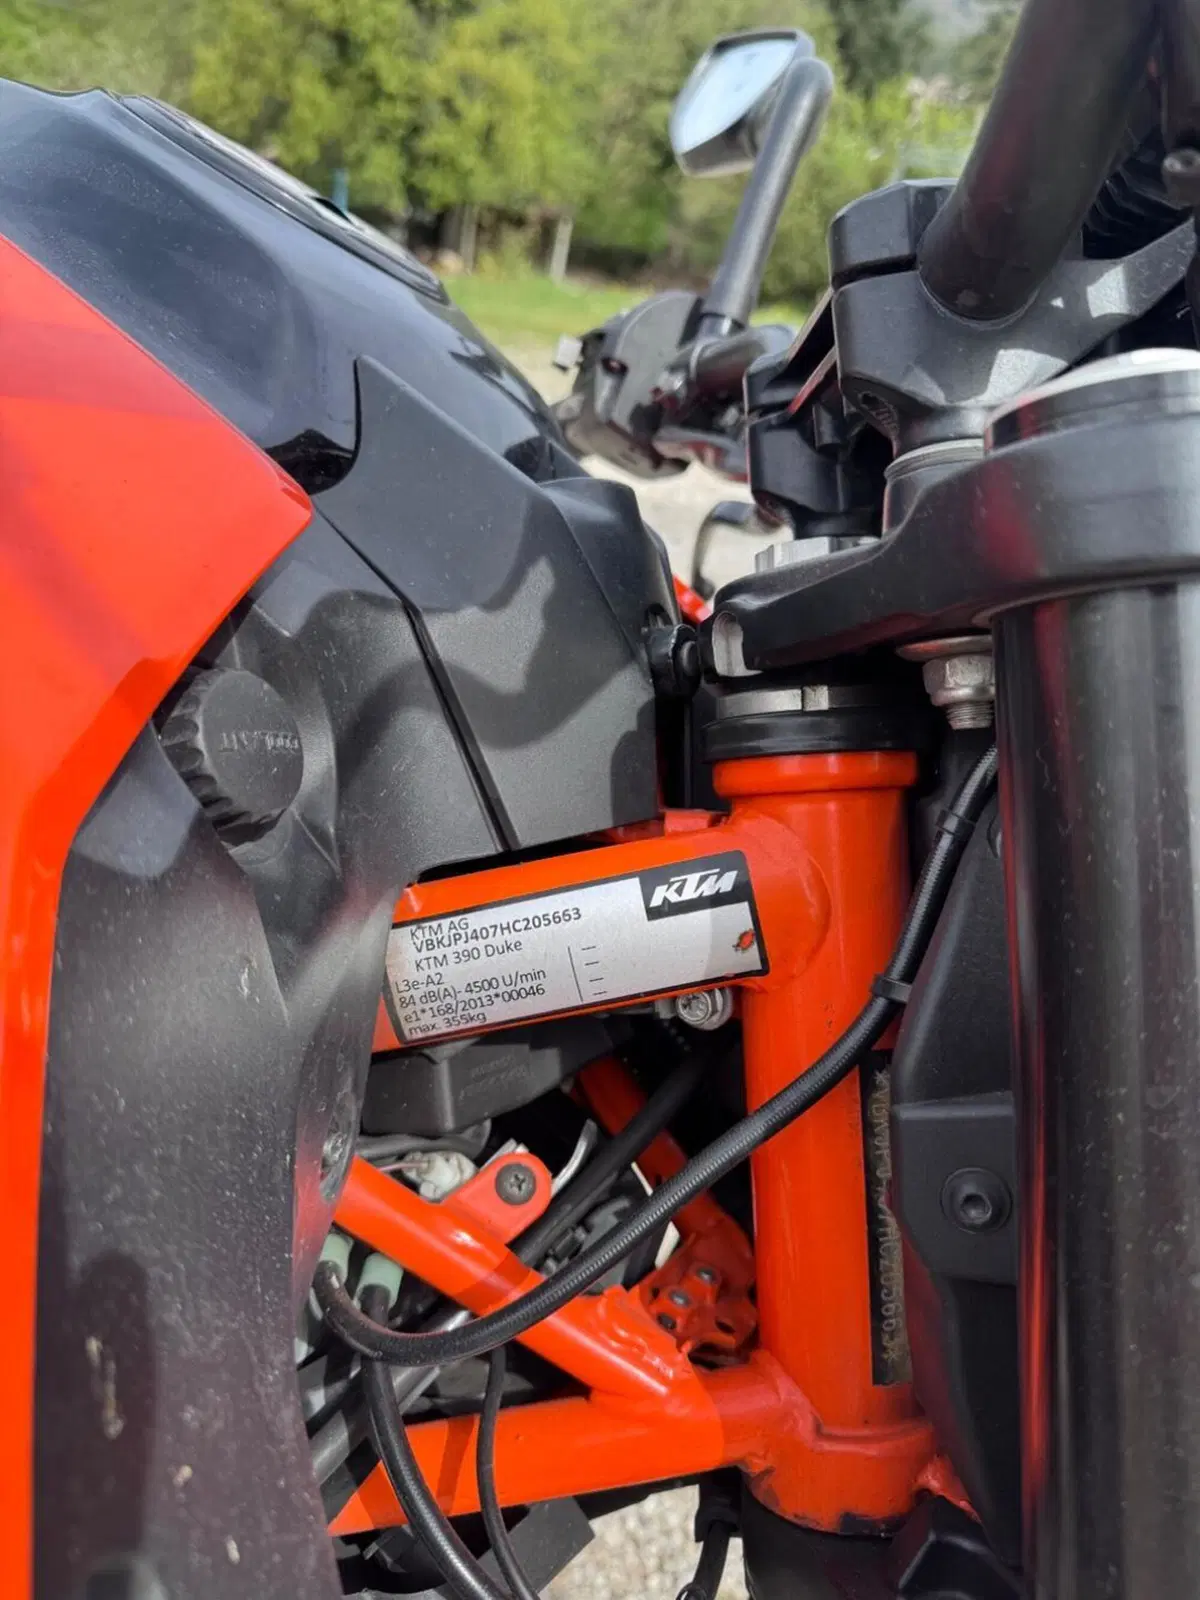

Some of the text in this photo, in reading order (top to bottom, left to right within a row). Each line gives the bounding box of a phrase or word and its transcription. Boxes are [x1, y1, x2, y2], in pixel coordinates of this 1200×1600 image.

[649, 868, 738, 908] KTM
[410, 917, 470, 941] KTM AG
[412, 907, 582, 953] VBKJPJ407HC205663
[415, 940, 523, 972] KTM 390 Duke
[395, 972, 445, 994] L3e-A2
[399, 996, 417, 1009] 84
[465, 977, 499, 995] 4500
[501, 968, 546, 987] U/min
[408, 1011, 487, 1036] max. 355kg
